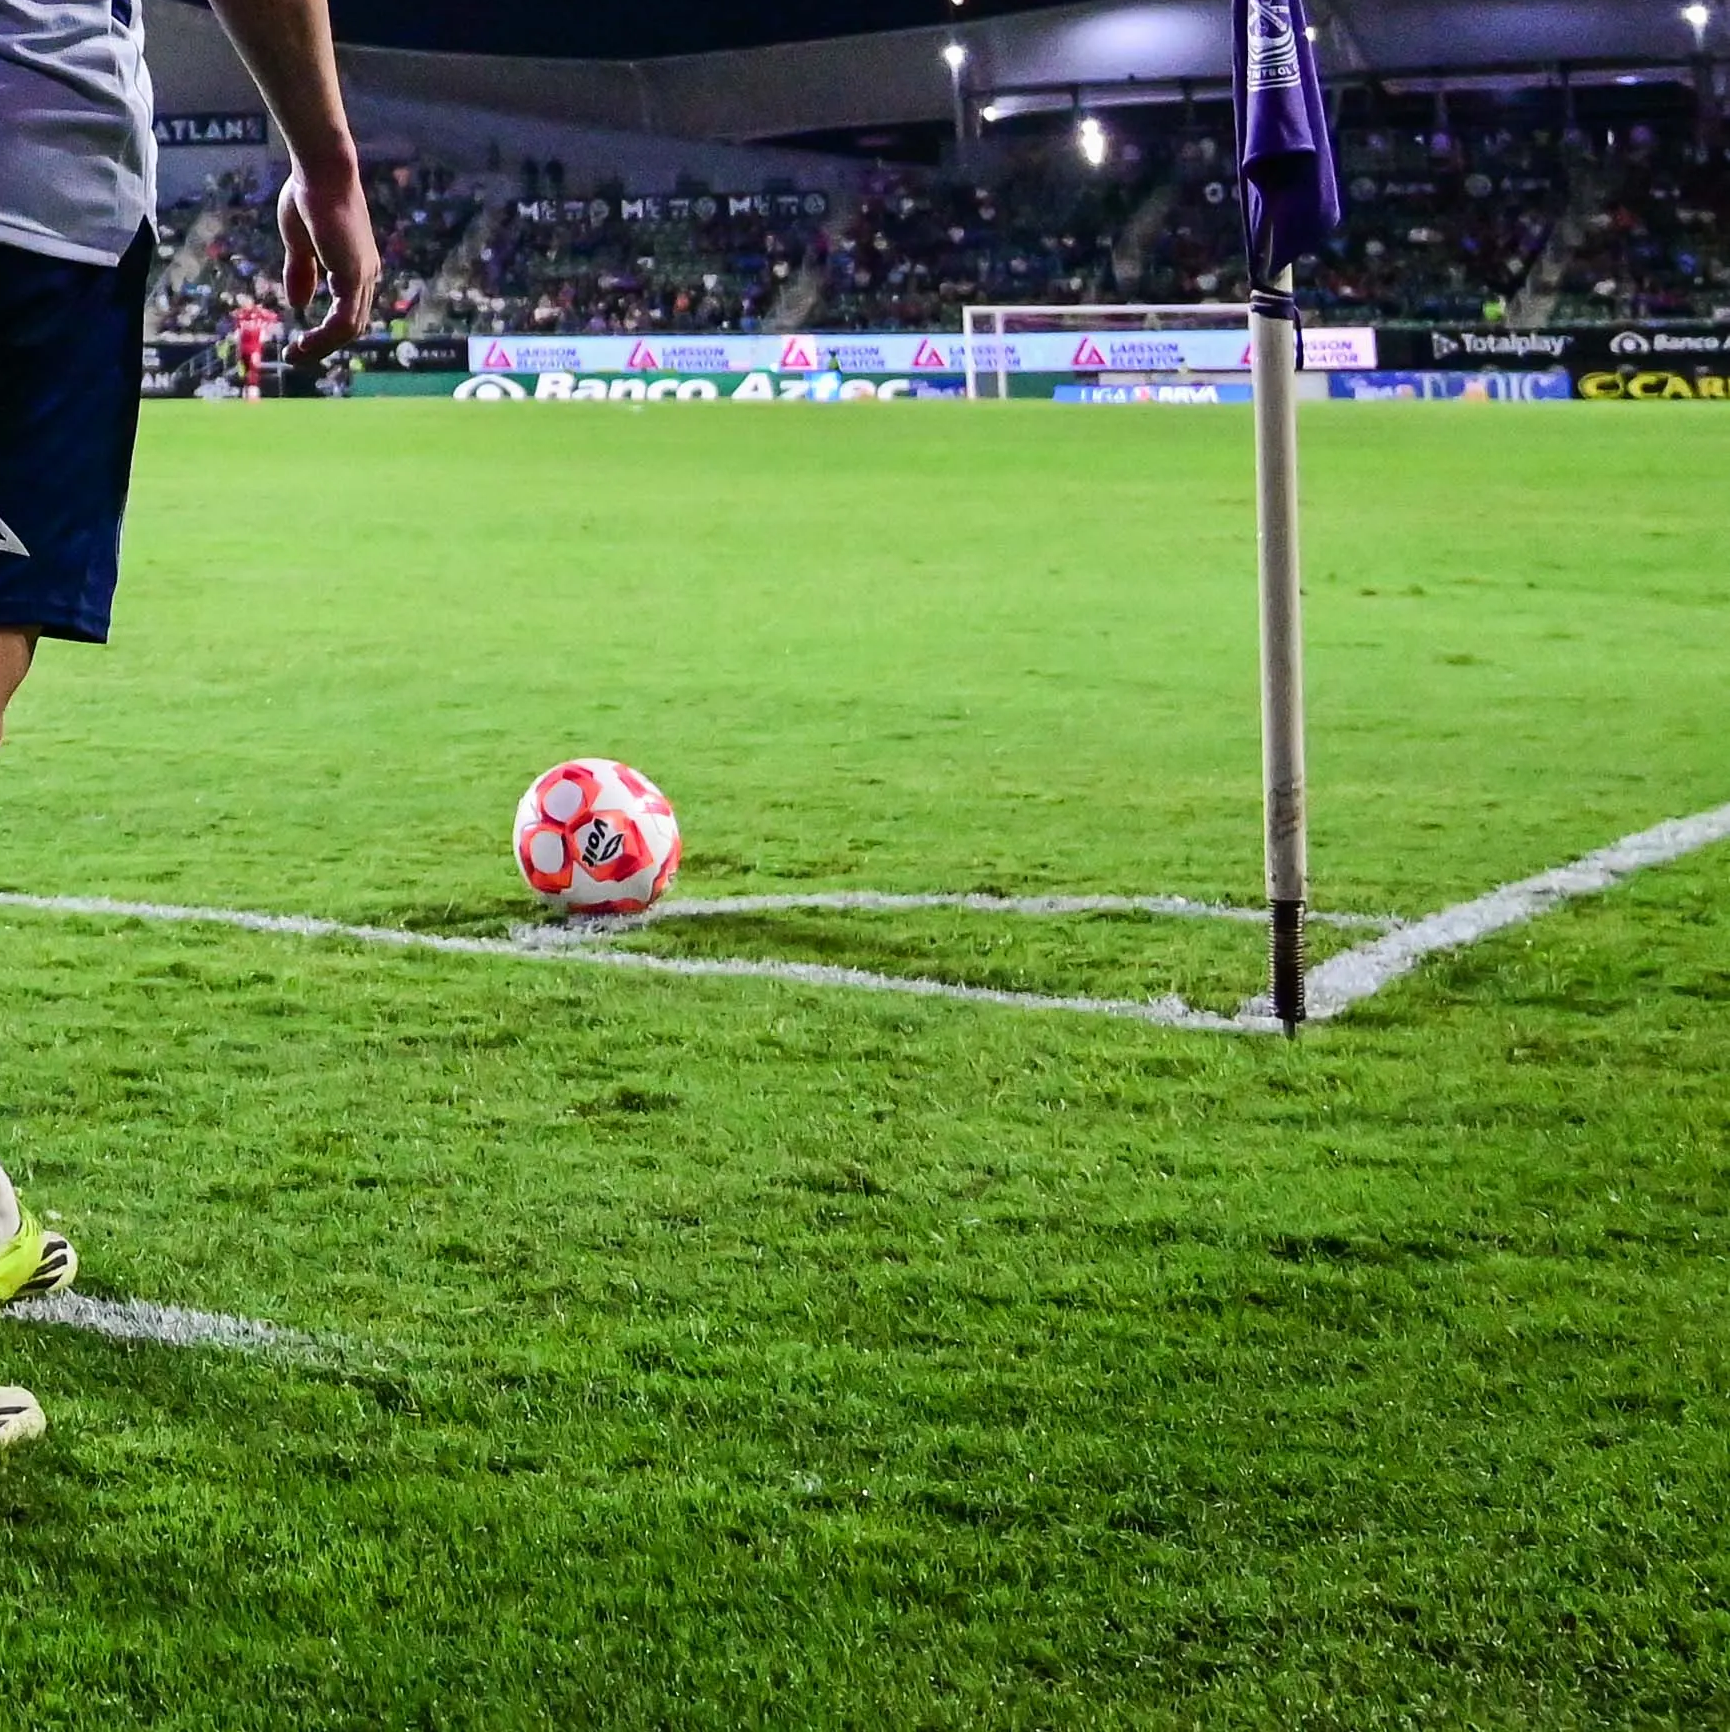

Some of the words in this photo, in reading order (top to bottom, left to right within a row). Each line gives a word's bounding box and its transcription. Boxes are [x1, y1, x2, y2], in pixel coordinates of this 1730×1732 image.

[1461, 333, 1565, 357] Totalplay
[535, 372, 719, 400] Banco
[1081, 386, 1126, 402] LIGA
